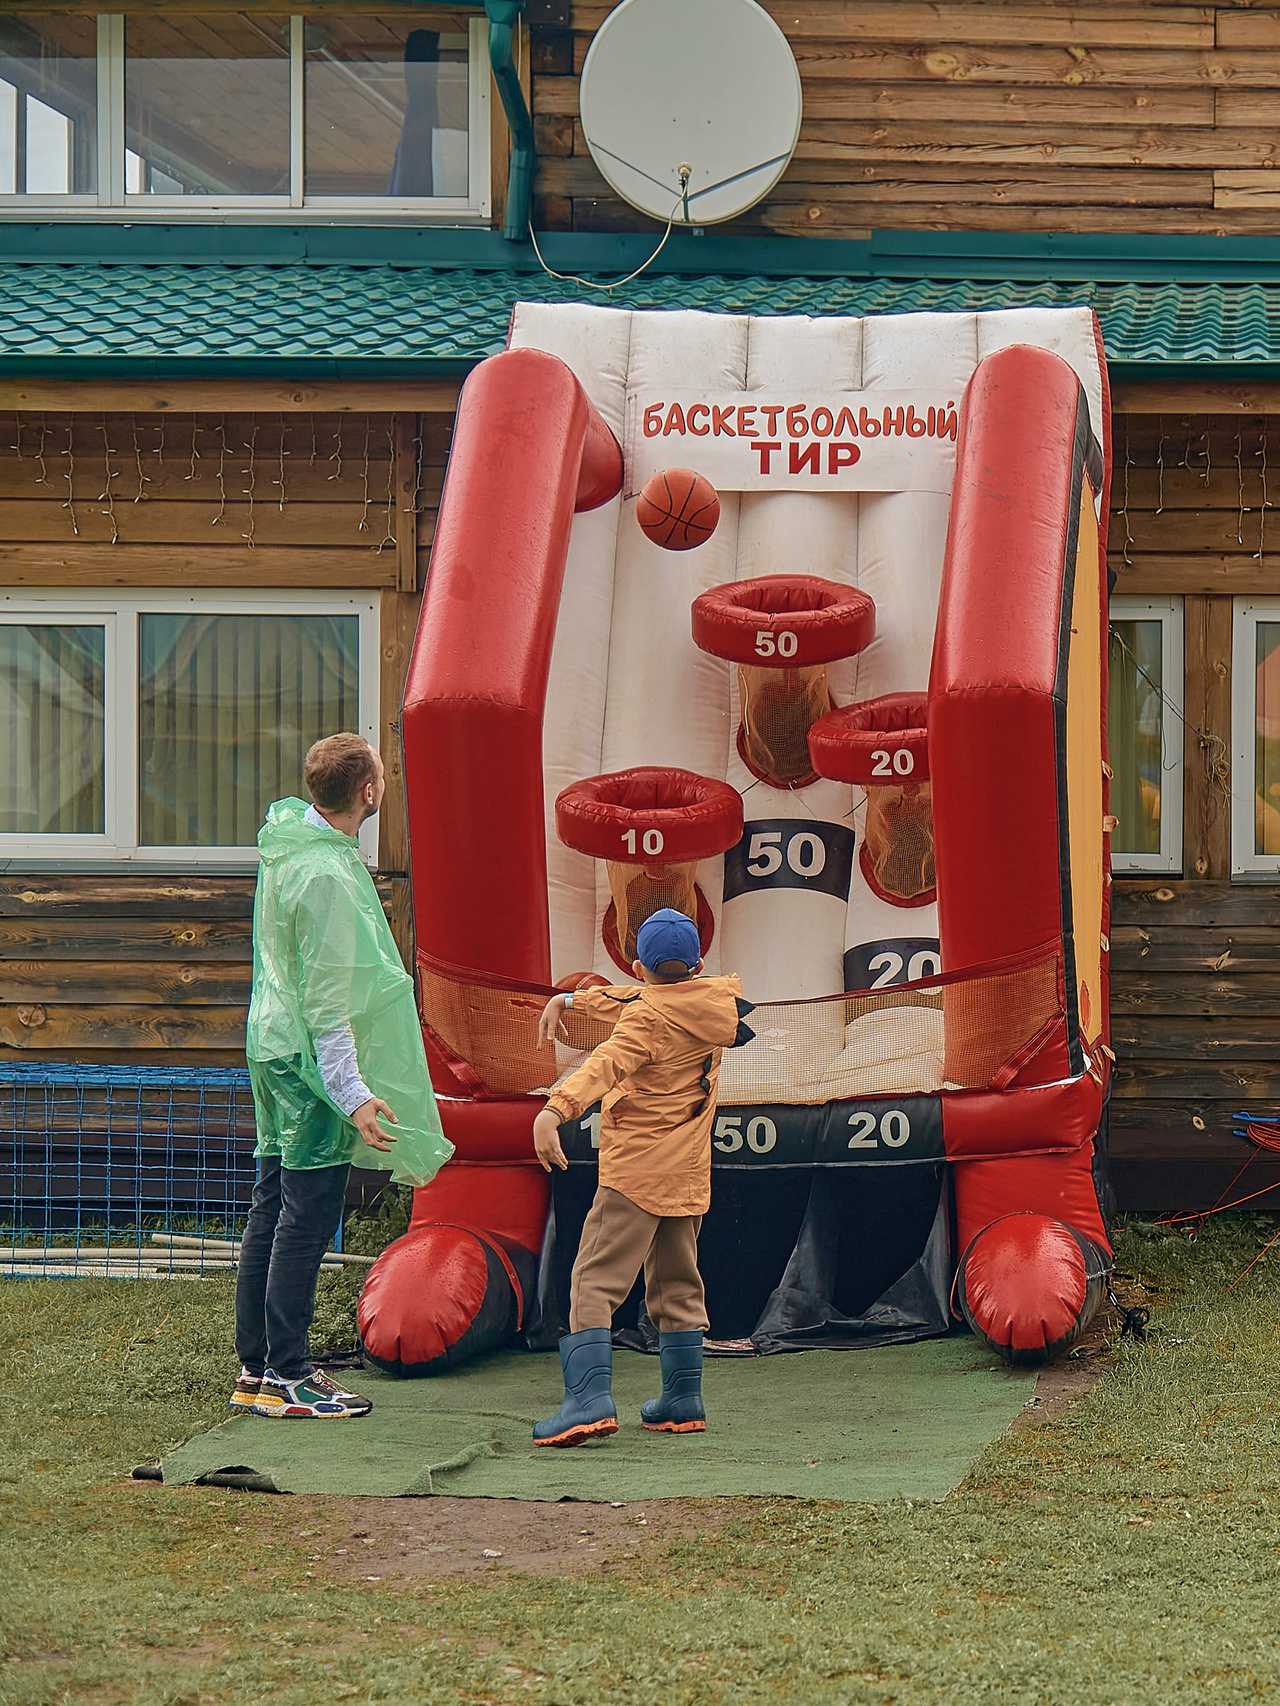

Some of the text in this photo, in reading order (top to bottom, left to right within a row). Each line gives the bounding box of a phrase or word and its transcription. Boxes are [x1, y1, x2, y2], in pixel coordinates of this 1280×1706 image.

[643, 400, 957, 441] БАСКЕТБОЛЬНЫЙ
[750, 441, 861, 475] ТИР
[754, 631, 799, 657] 50
[870, 749, 914, 776] 20
[621, 828, 664, 855] 10
[746, 832, 825, 877] 50
[868, 951, 942, 997] 20
[580, 1110, 910, 1153] 1 50 20
